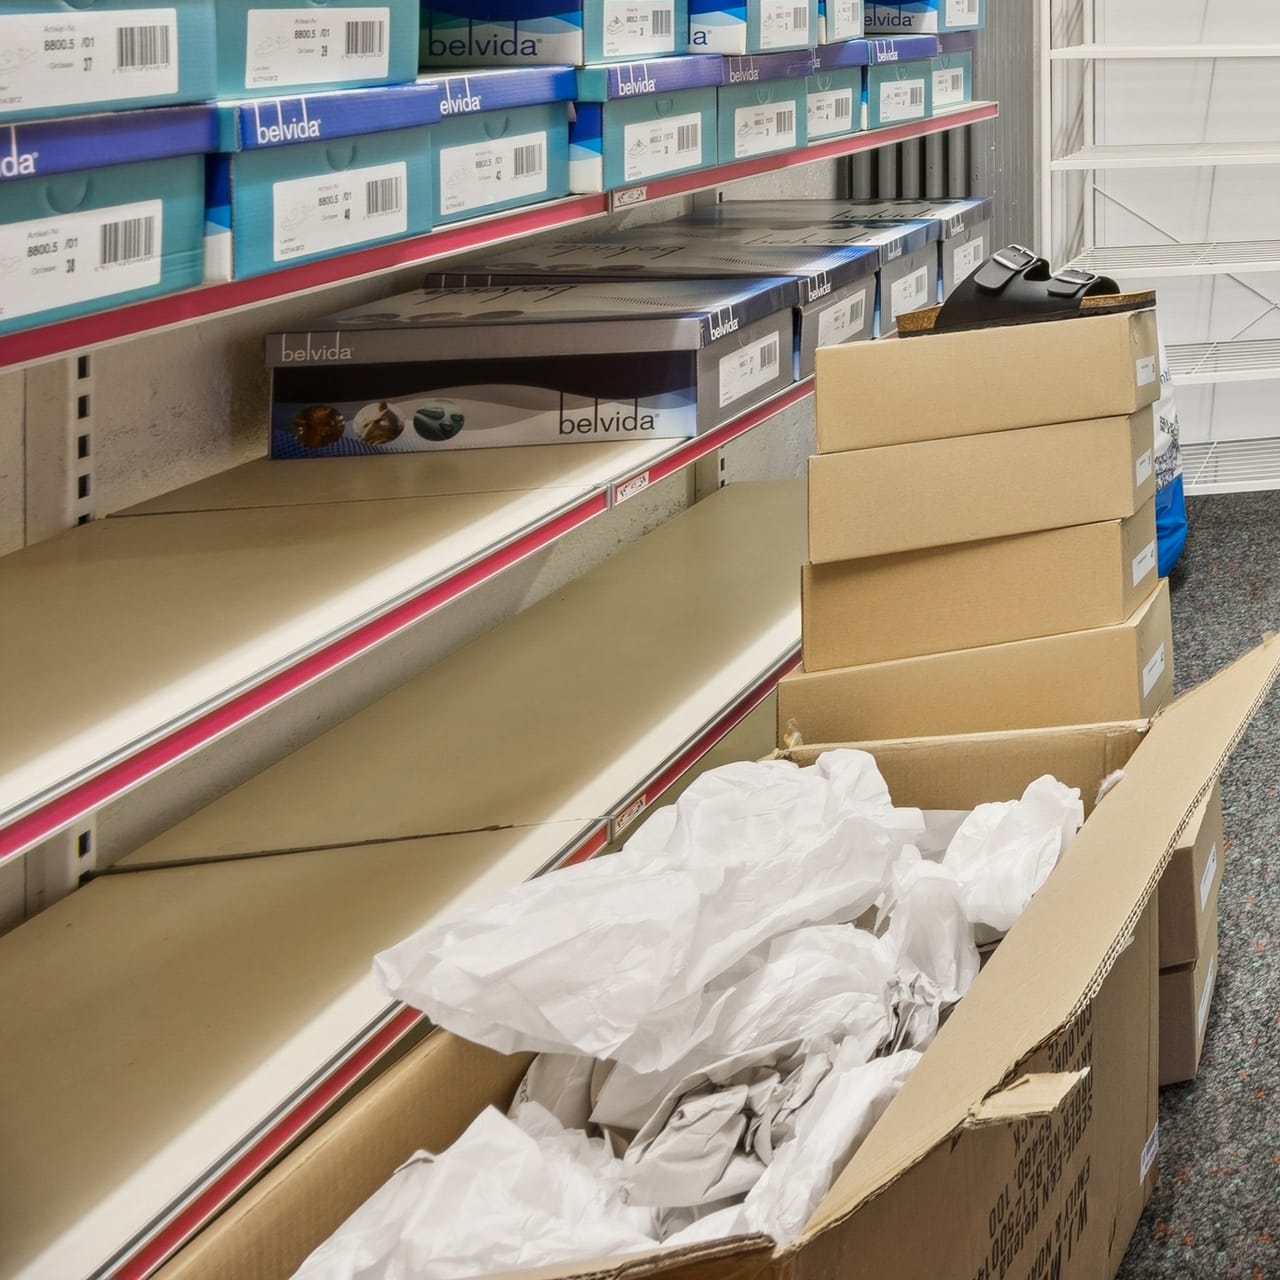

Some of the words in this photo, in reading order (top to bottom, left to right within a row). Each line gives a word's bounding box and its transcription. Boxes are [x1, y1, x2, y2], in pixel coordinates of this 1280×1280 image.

[864, 3, 912, 28] elvida
[44, 37, 75, 52] 8800.5
[294, 29, 316, 40] 8800.5
[428, 14, 538, 57] belvida
[876, 40, 898, 61] belvida
[617, 63, 656, 96] belvida
[729, 57, 759, 82] belvida
[440, 77, 481, 115] elvida
[255, 98, 321, 144] belvida
[318, 194, 340, 208] 8800.5
[27, 242, 58, 258] 8800.5
[807, 271, 832, 302] belvida
[708, 305, 738, 341] belvida
[281, 331, 352, 362] belvida
[560, 390, 655, 435] belvida
[1063, 1155, 1091, 1222] EMILY
[988, 1183, 1010, 1239] 100
